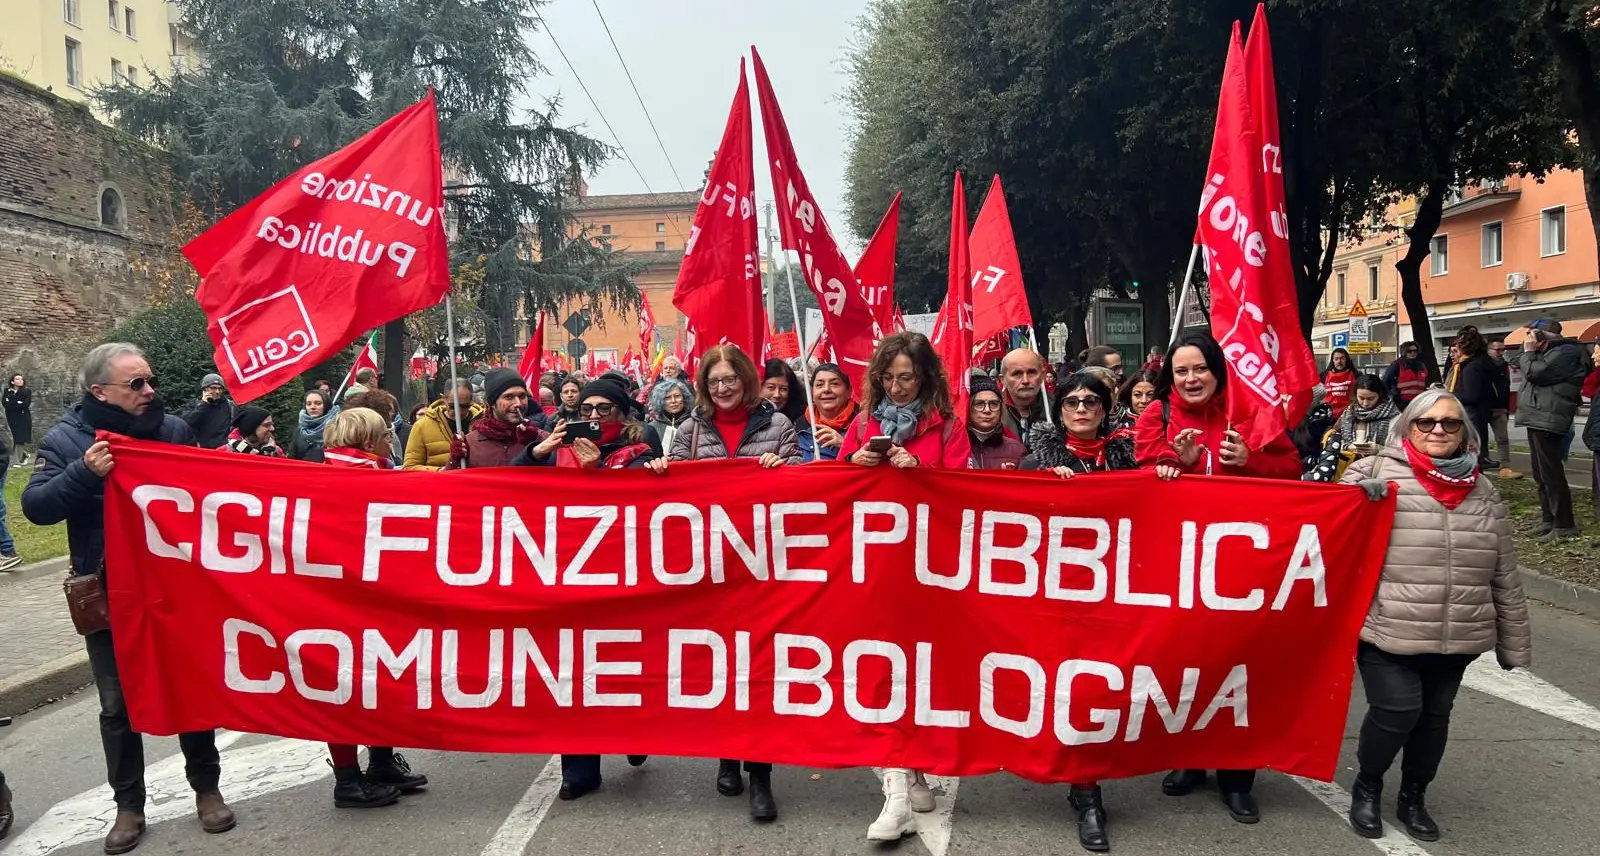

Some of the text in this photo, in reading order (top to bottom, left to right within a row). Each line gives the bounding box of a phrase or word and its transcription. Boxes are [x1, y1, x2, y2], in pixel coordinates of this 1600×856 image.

[1223, 342, 1279, 398] CGIL
[1335, 335, 1345, 346] P
[132, 485, 1328, 611] CGIL FUNZIONE PUBBLICA
[223, 618, 1249, 746] COMUNE DI BOLOGNA
